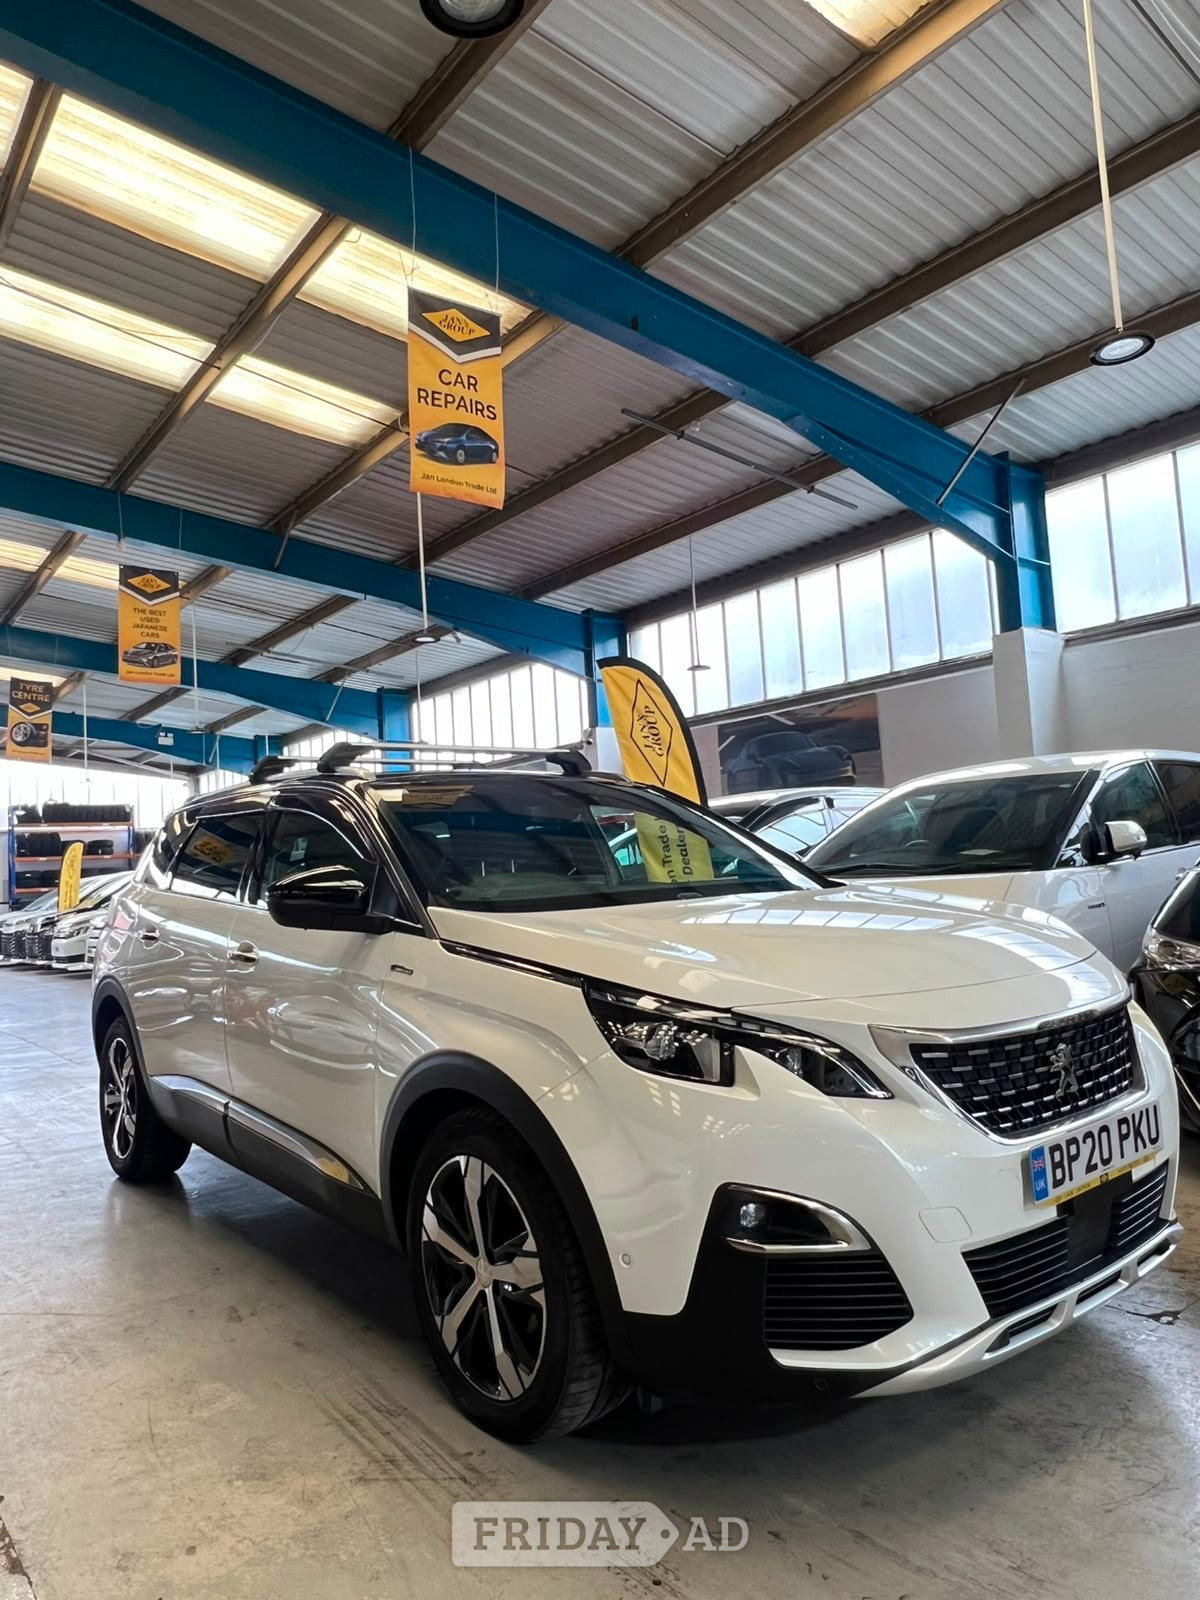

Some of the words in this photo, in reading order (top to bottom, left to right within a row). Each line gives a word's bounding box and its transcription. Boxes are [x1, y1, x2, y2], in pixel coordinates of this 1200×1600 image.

[439, 320, 475, 336] GROUP
[438, 369, 478, 392] CAR
[417, 387, 497, 420] REPAIRS
[421, 472, 435, 480] Jan
[436, 475, 464, 487] London
[465, 481, 484, 491] Trade
[486, 486, 497, 494] Ltd
[133, 607, 146, 615] THE
[132, 623, 168, 632] JAPANESE
[140, 631, 160, 639] CARS
[12, 690, 50, 702] CENTRE
[20, 683, 45, 693] TYRE
[644, 705, 664, 757] GROUP
[659, 824, 673, 868] Trade
[677, 829, 693, 875] Dealer
[1048, 1124, 1113, 1190] BP20
[1117, 1104, 1160, 1159] PKU
[1035, 1178, 1046, 1191] UK
